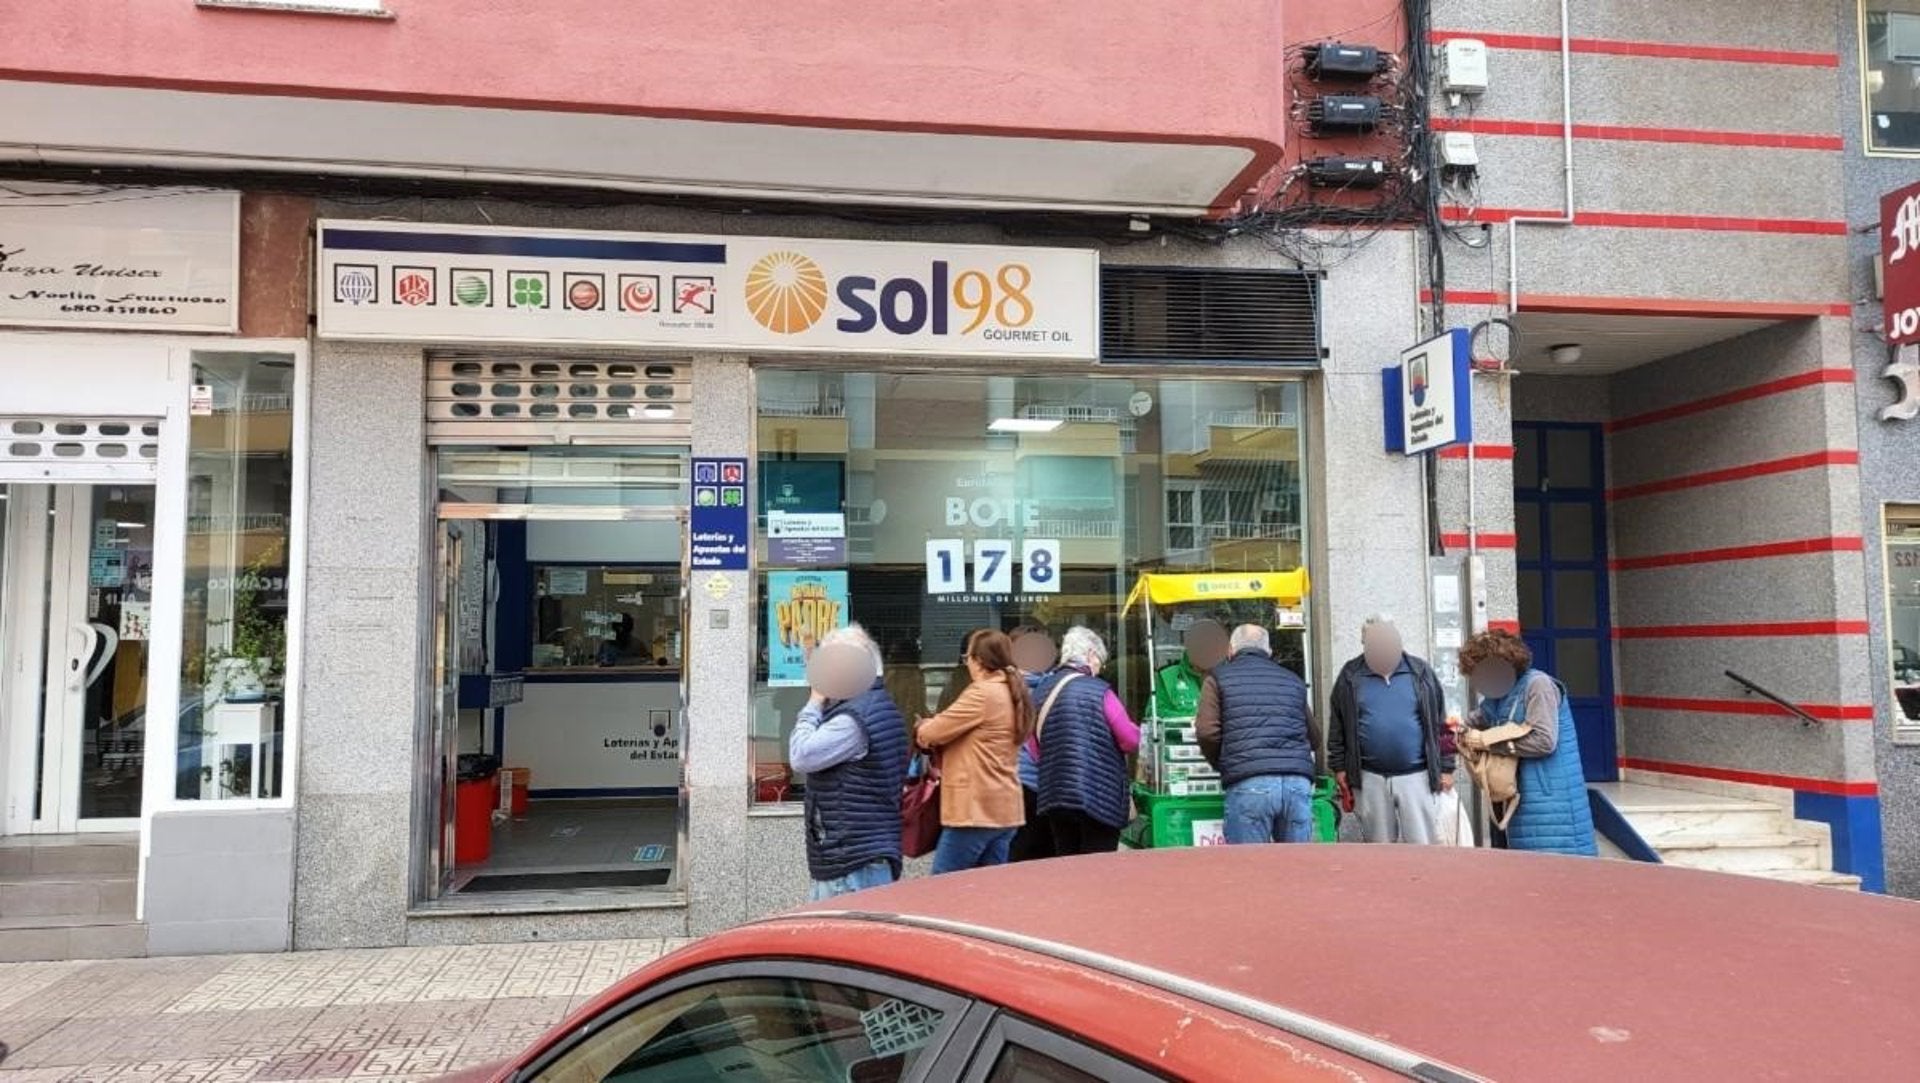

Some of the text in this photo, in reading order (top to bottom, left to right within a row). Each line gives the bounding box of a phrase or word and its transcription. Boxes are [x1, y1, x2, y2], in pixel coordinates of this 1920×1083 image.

[983, 328, 1073, 343] GOURMET OIL
[945, 497, 1040, 528] BOTE
[937, 595, 1050, 603] MILLONES DE EUROS
[630, 750, 647, 761] del
